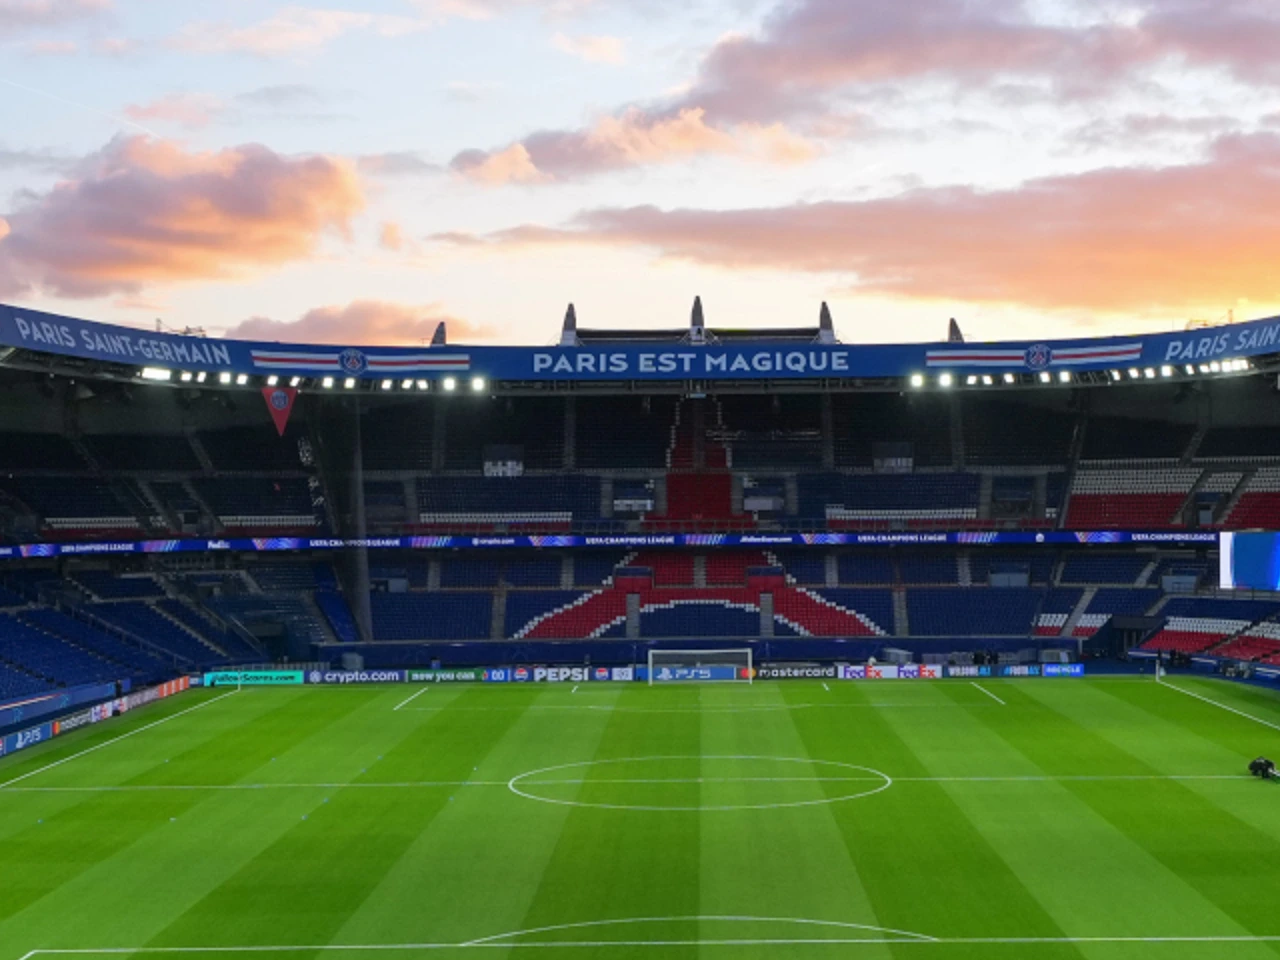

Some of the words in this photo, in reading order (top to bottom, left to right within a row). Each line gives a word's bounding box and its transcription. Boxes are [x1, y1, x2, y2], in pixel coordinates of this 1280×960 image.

[16, 317, 76, 348] PARIS
[80, 330, 231, 365] SAINT-GERMAIN
[1165, 333, 1228, 361] PARIS
[533, 353, 627, 373] PARIS
[638, 353, 698, 373] EST
[705, 351, 850, 372] MAGIQUE
[325, 671, 400, 683] crypto.com
[534, 667, 589, 681] PEPSI
[676, 669, 711, 679] PS5
[760, 667, 834, 677] mastercard
[897, 665, 936, 678] FedEx
